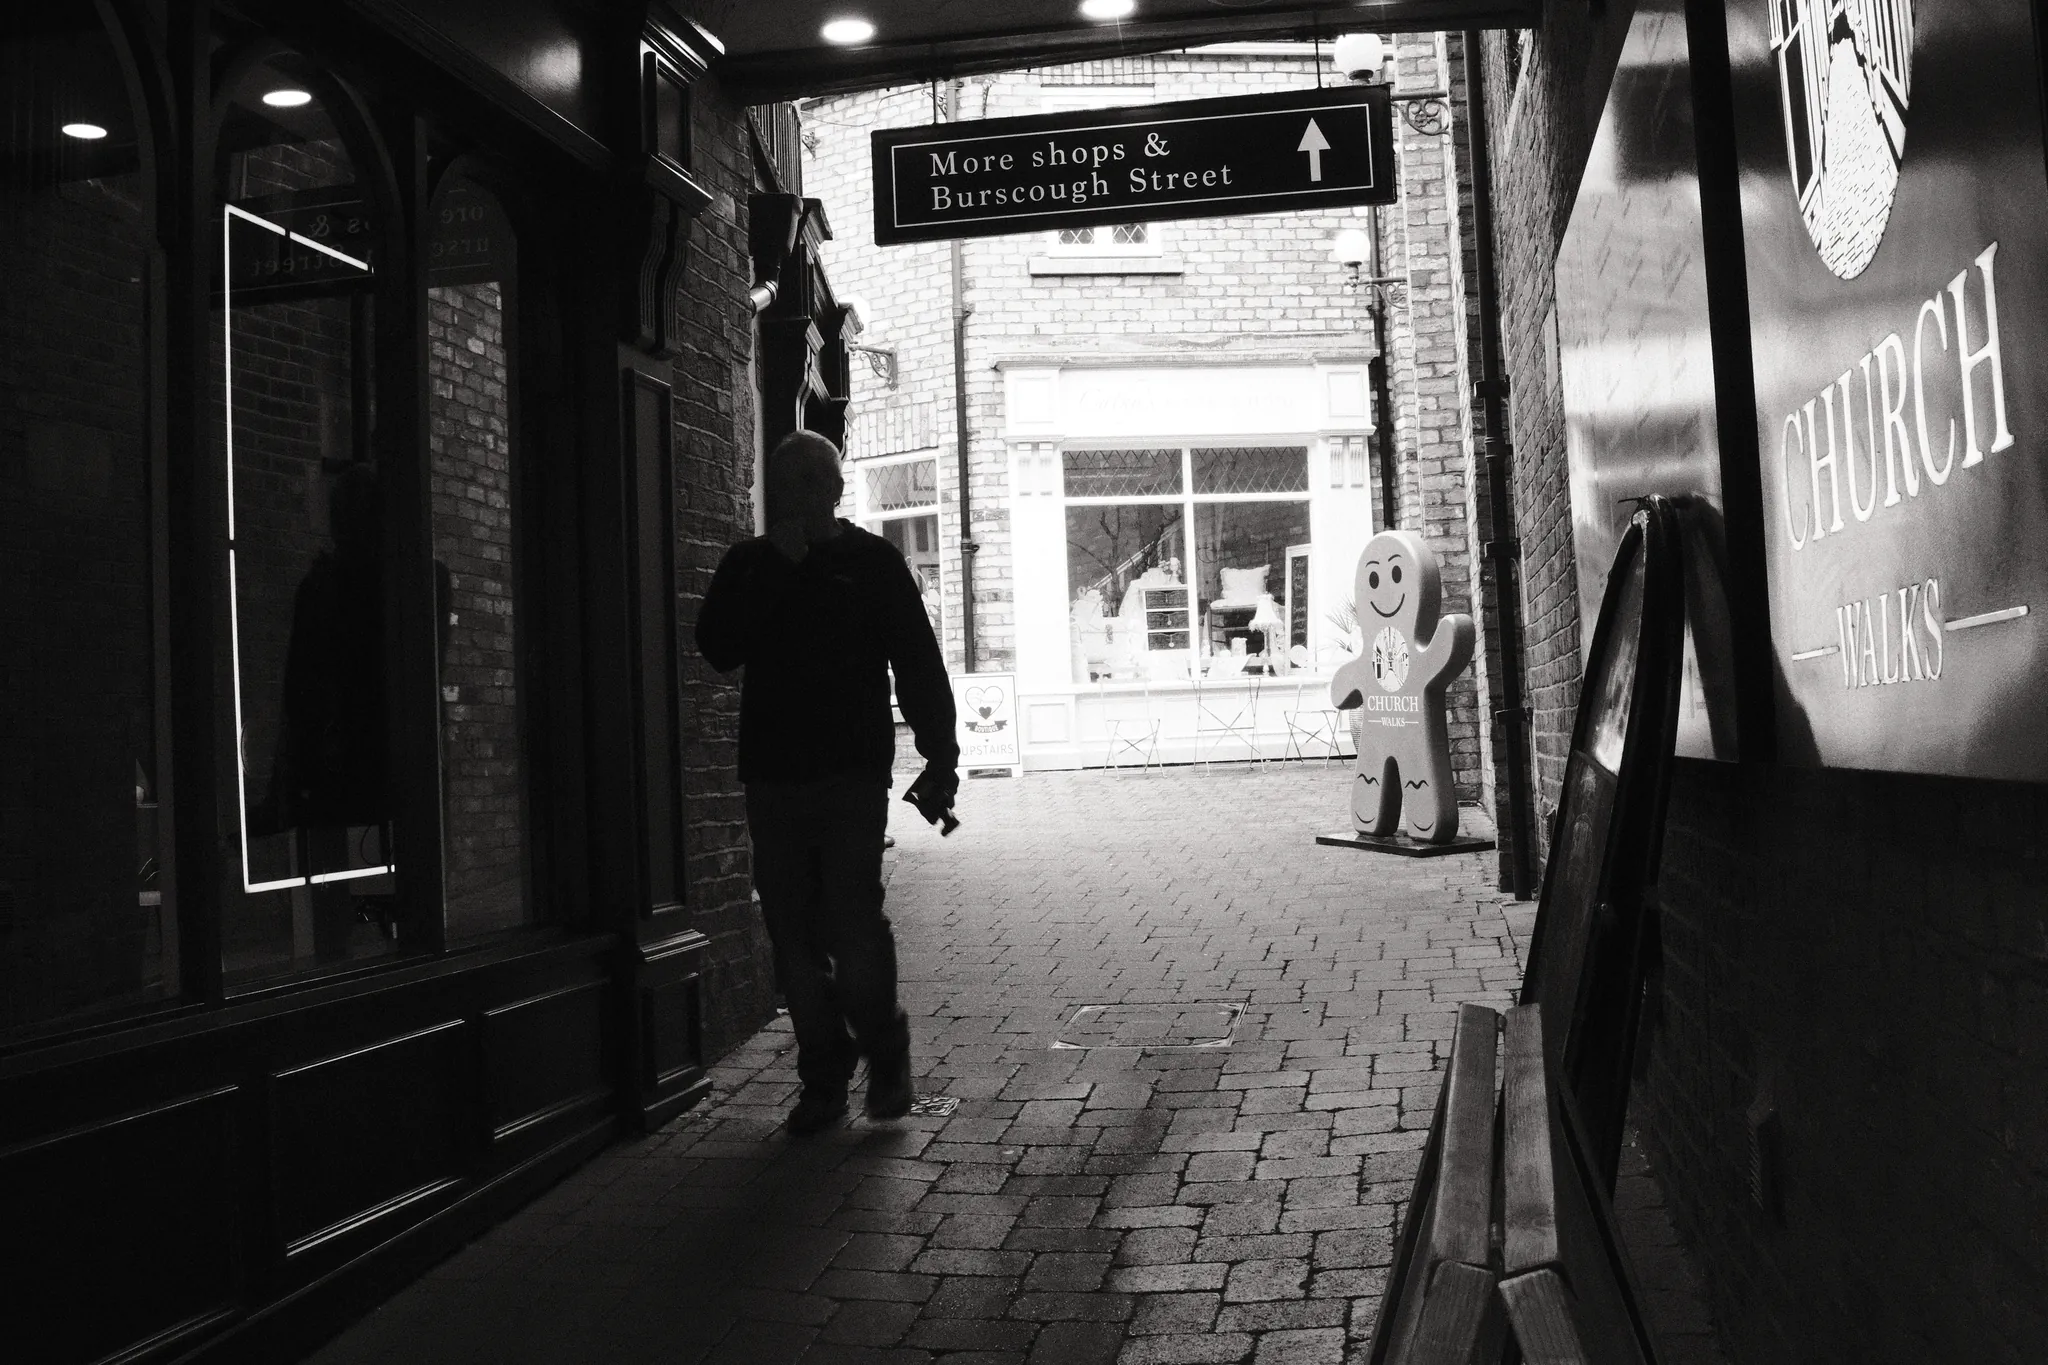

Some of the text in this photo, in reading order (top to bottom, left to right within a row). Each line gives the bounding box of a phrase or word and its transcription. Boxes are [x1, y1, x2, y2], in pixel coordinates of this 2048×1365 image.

[930, 132, 1171, 177] More shops &
[930, 164, 1233, 211] Burscough Street
[1781, 240, 2015, 551] CHURCH
[1836, 578, 1943, 689] WALKS
[1367, 695, 1419, 712] CHURCH
[1381, 716, 1406, 727] WALKS
[961, 743, 1014, 756] UPSTAIRS
